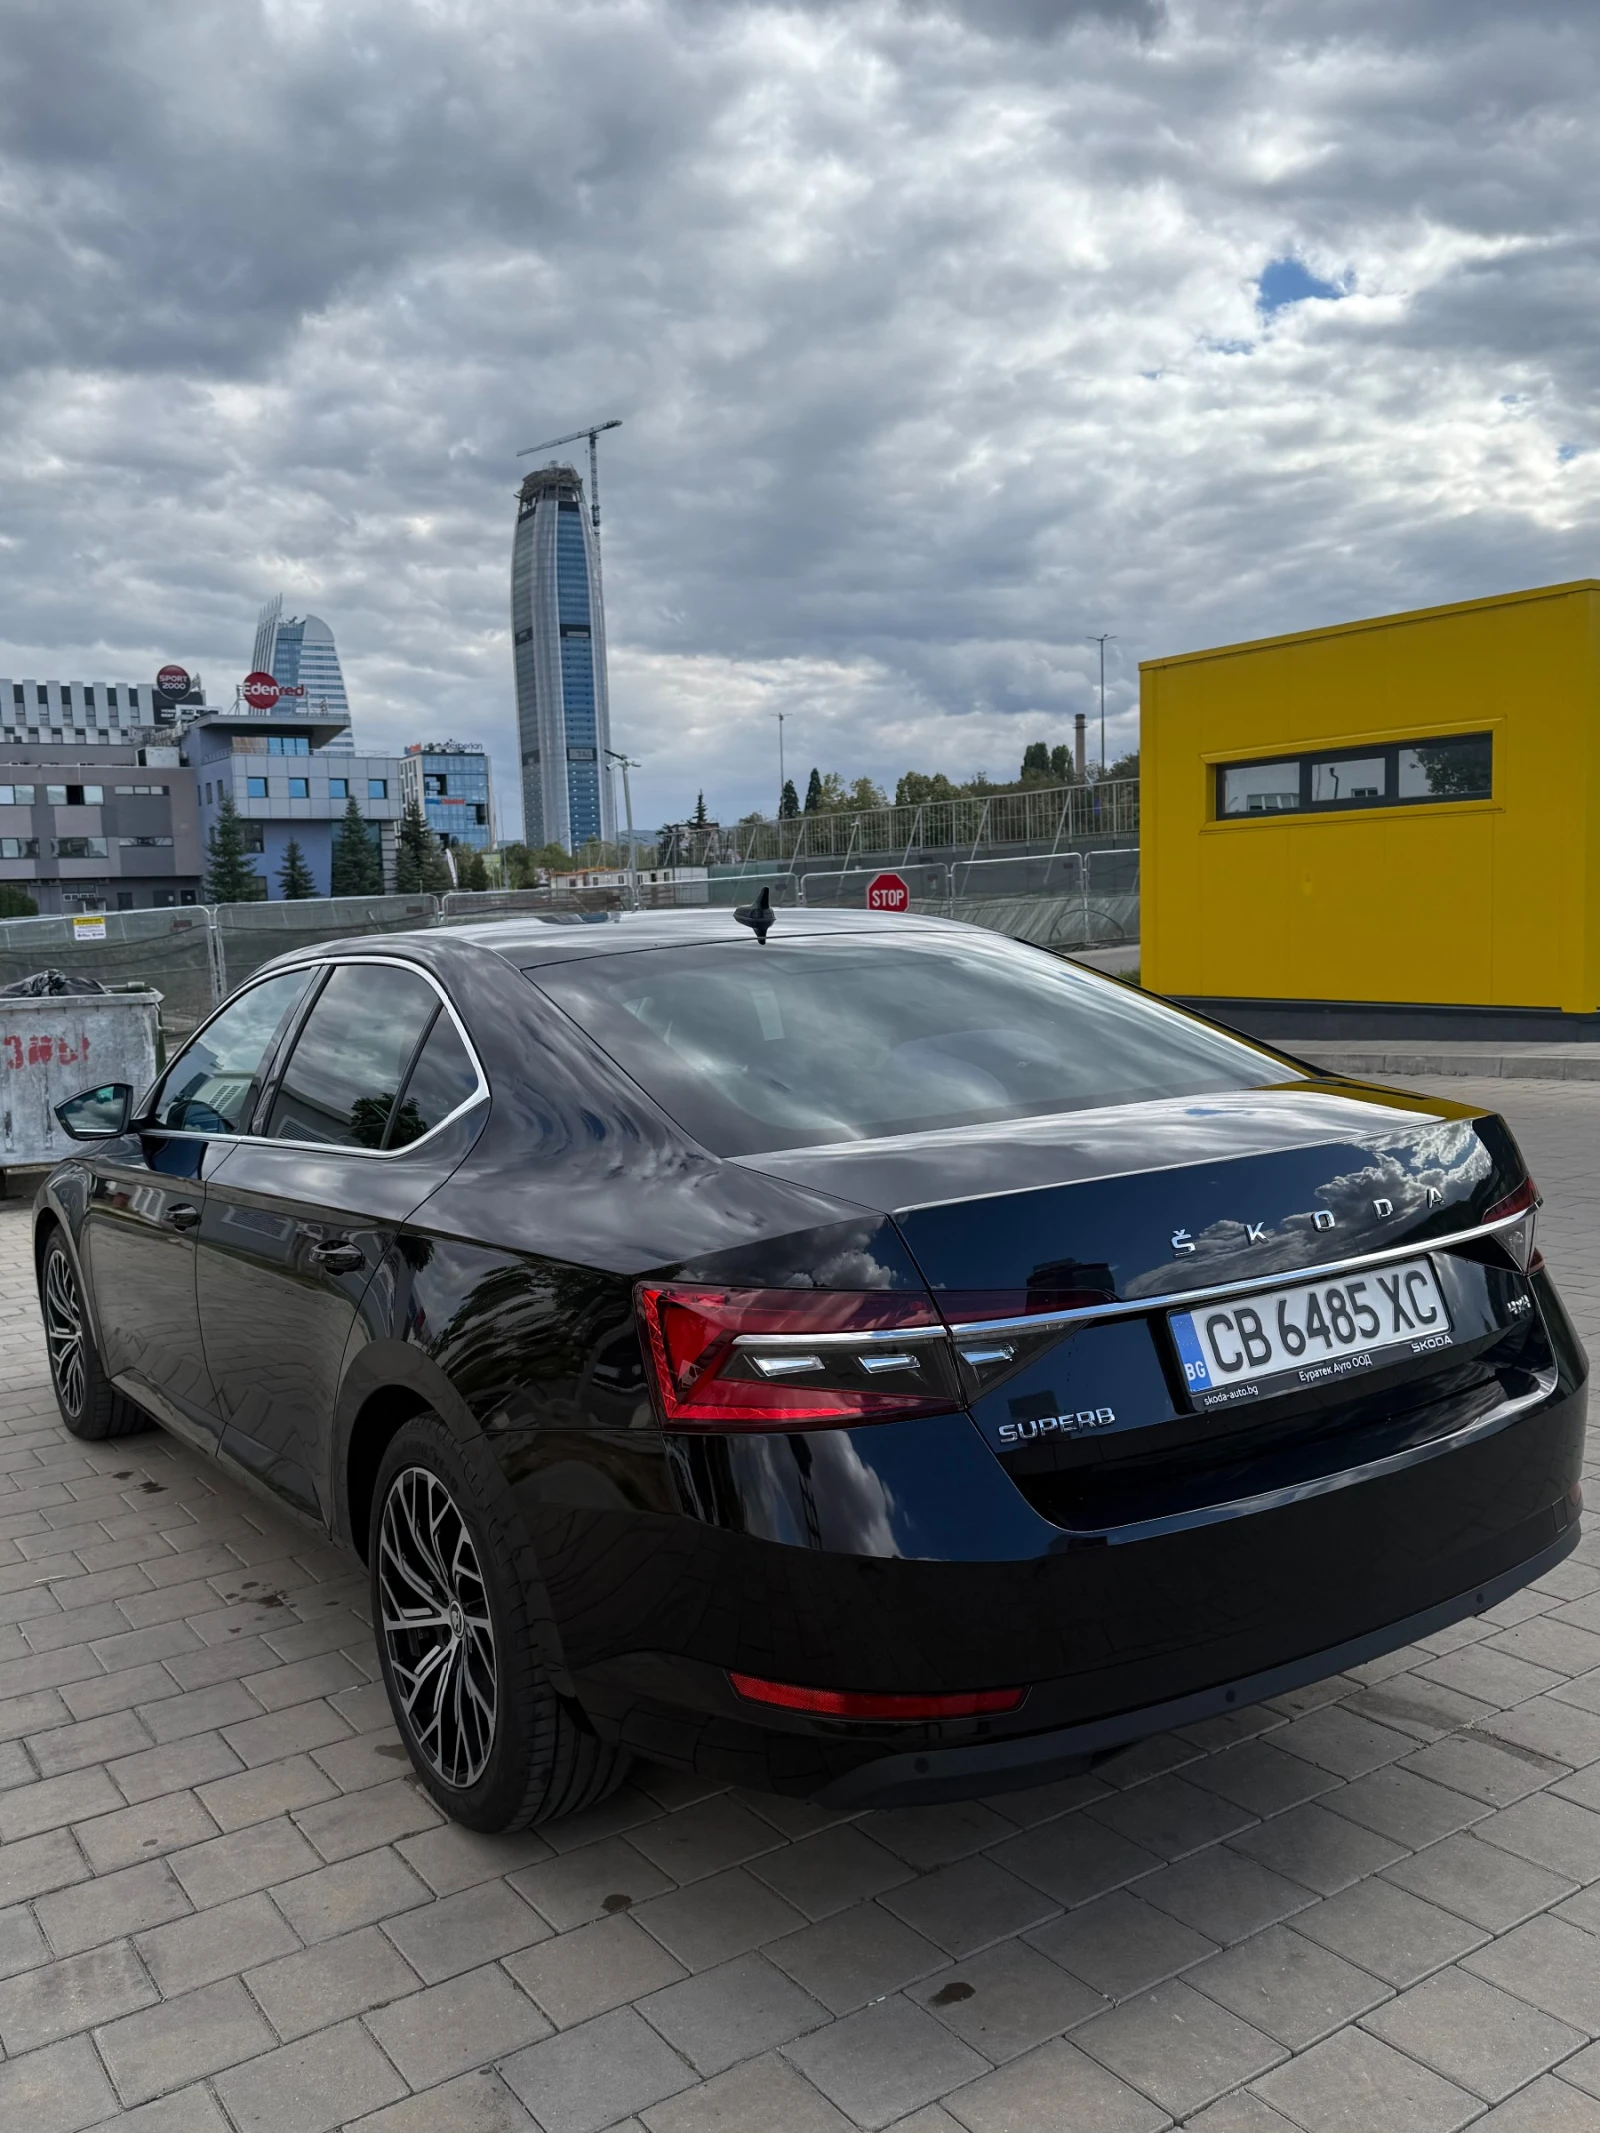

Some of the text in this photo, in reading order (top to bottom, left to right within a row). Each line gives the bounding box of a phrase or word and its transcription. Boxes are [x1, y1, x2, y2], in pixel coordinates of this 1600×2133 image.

[159, 674, 188, 683] SPORT
[162, 682, 187, 690] 2000
[243, 682, 305, 697] Edenred
[872, 889, 905, 907] STOP
[1206, 1269, 1438, 1374] CB 6485 XC
[1351, 1353, 1373, 1369] ООД
[1184, 1360, 1207, 1382] BG
[1203, 1385, 1259, 1406] skoda-auto.bg
[998, 1407, 1116, 1443] SUPERB
